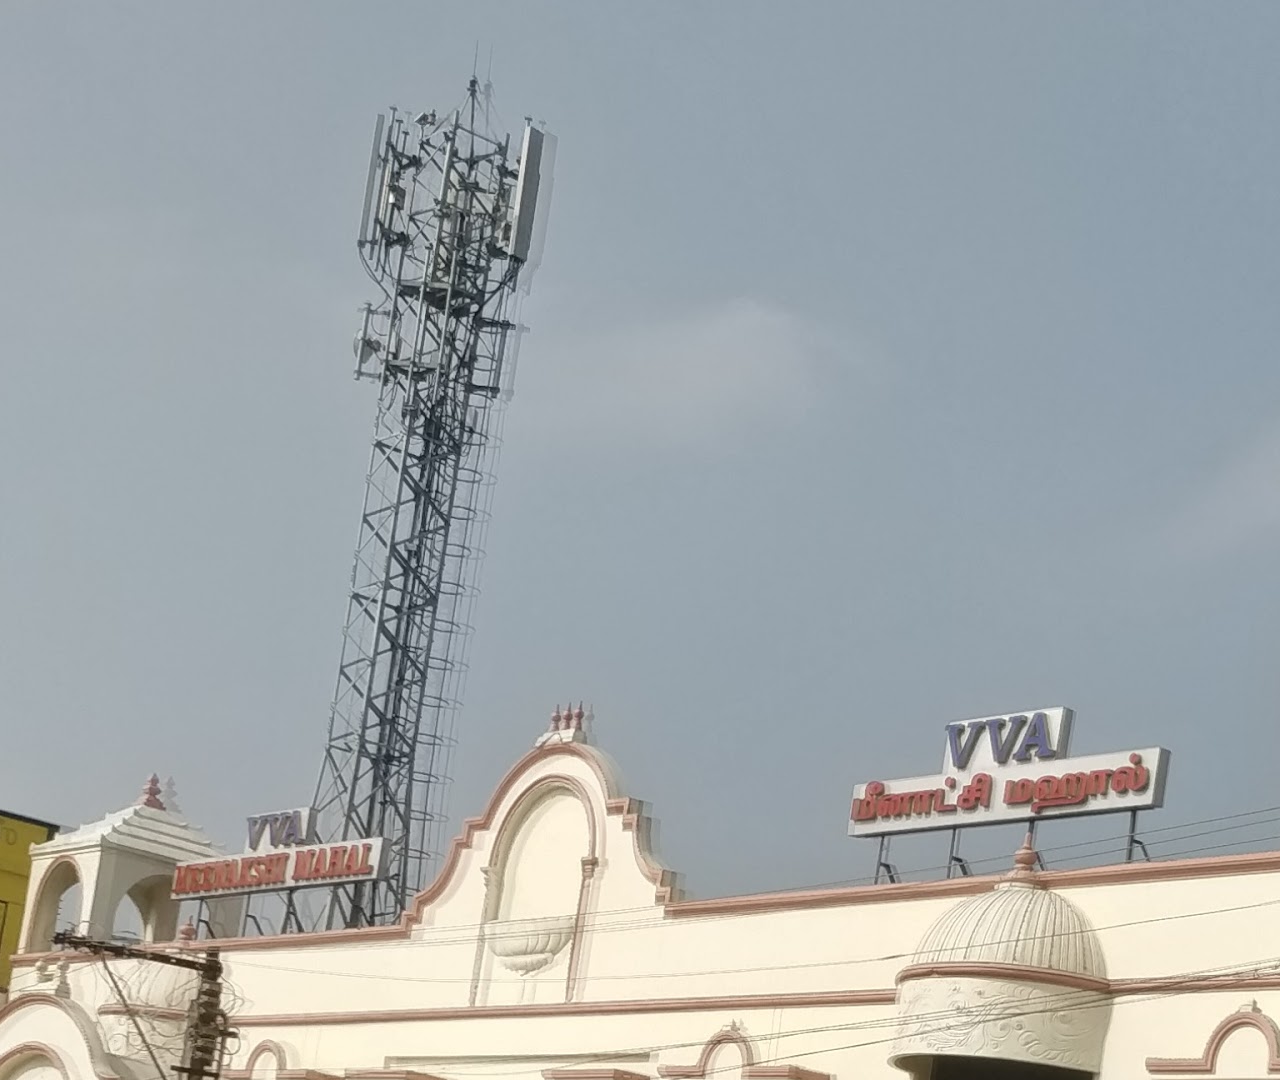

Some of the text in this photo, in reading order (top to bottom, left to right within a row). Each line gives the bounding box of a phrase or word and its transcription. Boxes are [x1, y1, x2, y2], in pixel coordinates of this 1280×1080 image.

[945, 712, 1057, 769] VVA
[1002, 752, 1151, 814] மஹால்
[247, 810, 303, 851] VVA
[292, 843, 374, 880] MAHAL
